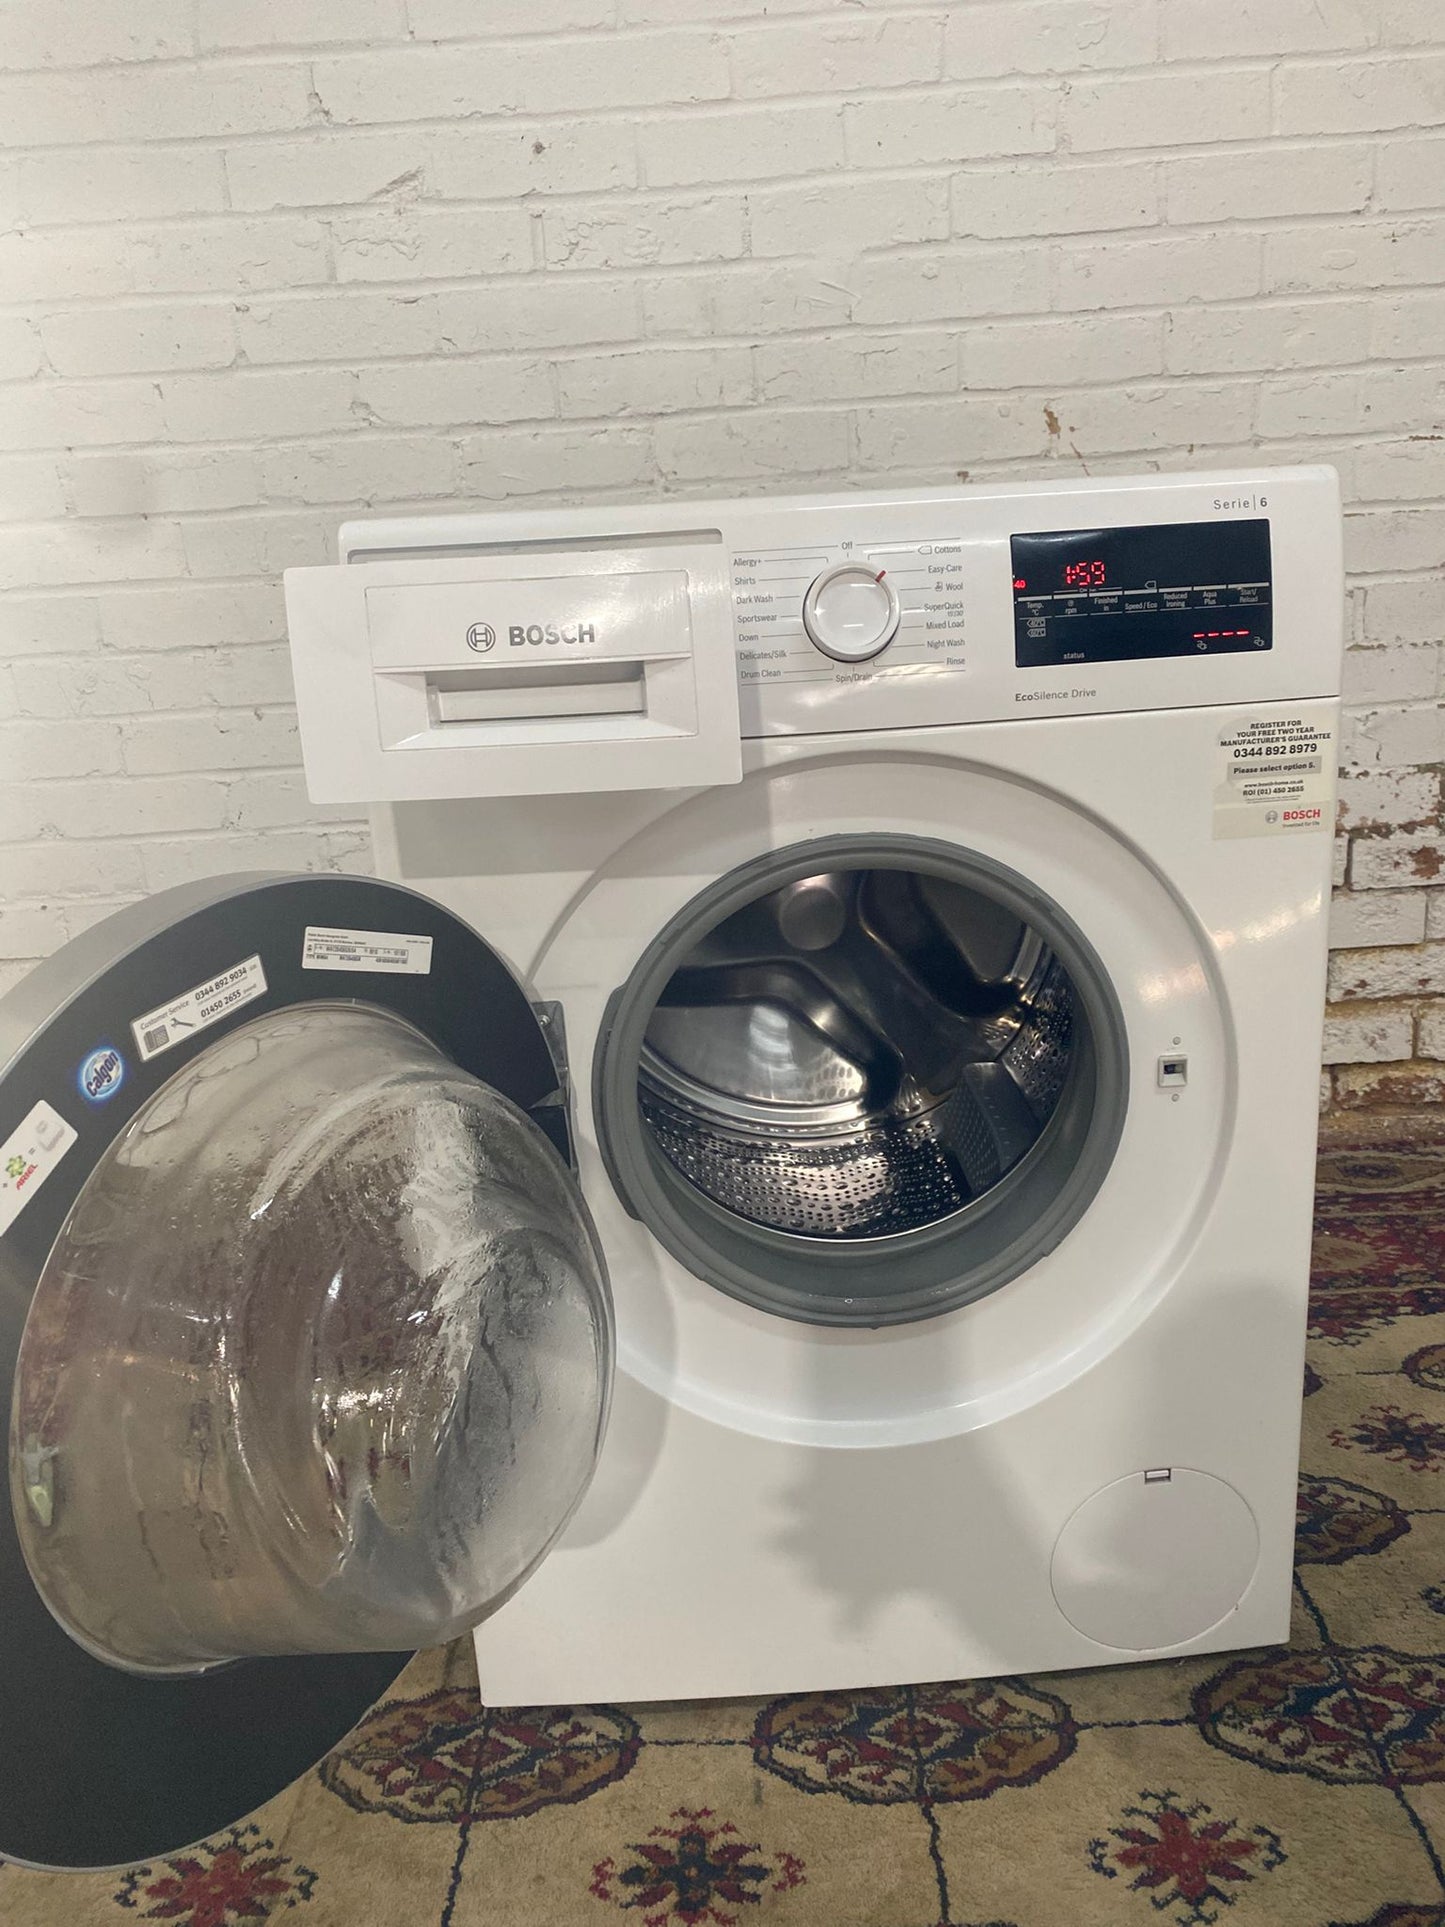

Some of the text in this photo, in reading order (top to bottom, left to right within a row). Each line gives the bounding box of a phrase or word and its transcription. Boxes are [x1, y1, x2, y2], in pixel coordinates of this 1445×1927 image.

[1213, 497, 1249, 510] Serie
[1260, 496, 1268, 508] 6
[841, 541, 853, 550] Off
[934, 546, 961, 554] Cottons
[733, 558, 761, 567] Allergy+
[1066, 561, 1105, 586] 1:59
[734, 576, 756, 585] Shirts
[1014, 580, 1027, 589] 40
[946, 582, 963, 591] Wool
[736, 594, 774, 604] Dark Wash
[1094, 596, 1118, 604] Finished
[1203, 591, 1218, 599] Aqua
[924, 601, 963, 612] SuperQuick
[1124, 602, 1142, 610] Speed
[737, 614, 777, 624] Sportswear
[926, 620, 964, 630] Mixed Load
[508, 623, 595, 646] BOSCH
[738, 634, 758, 642] Down
[927, 638, 966, 650] Night Wash
[740, 650, 787, 660] Delicates/Silk
[946, 657, 966, 665] Rinse
[741, 670, 781, 679] Drum Clean
[836, 672, 872, 683] Spin/Drain
[1015, 688, 1097, 702] EcoSilence Drive
[1250, 721, 1286, 730] REGISTER
[1236, 730, 1256, 738] YOUR
[1296, 726, 1314, 734] YEAR
[1220, 732, 1331, 746] MANUFACTURER'S GUARANTEE
[1234, 743, 1318, 758] 0344 892 8979
[1233, 766, 1258, 774] Please
[1283, 763, 1307, 772] option
[1242, 788, 1256, 796] ROI
[1283, 809, 1321, 820] BOSCH
[194, 985, 214, 1001] 0344
[214, 976, 229, 991] 892
[229, 966, 248, 982] 9034
[224, 989, 242, 1006] 2655
[140, 1000, 190, 1030] Customer Service
[16, 1164, 38, 1190] ARIEL
